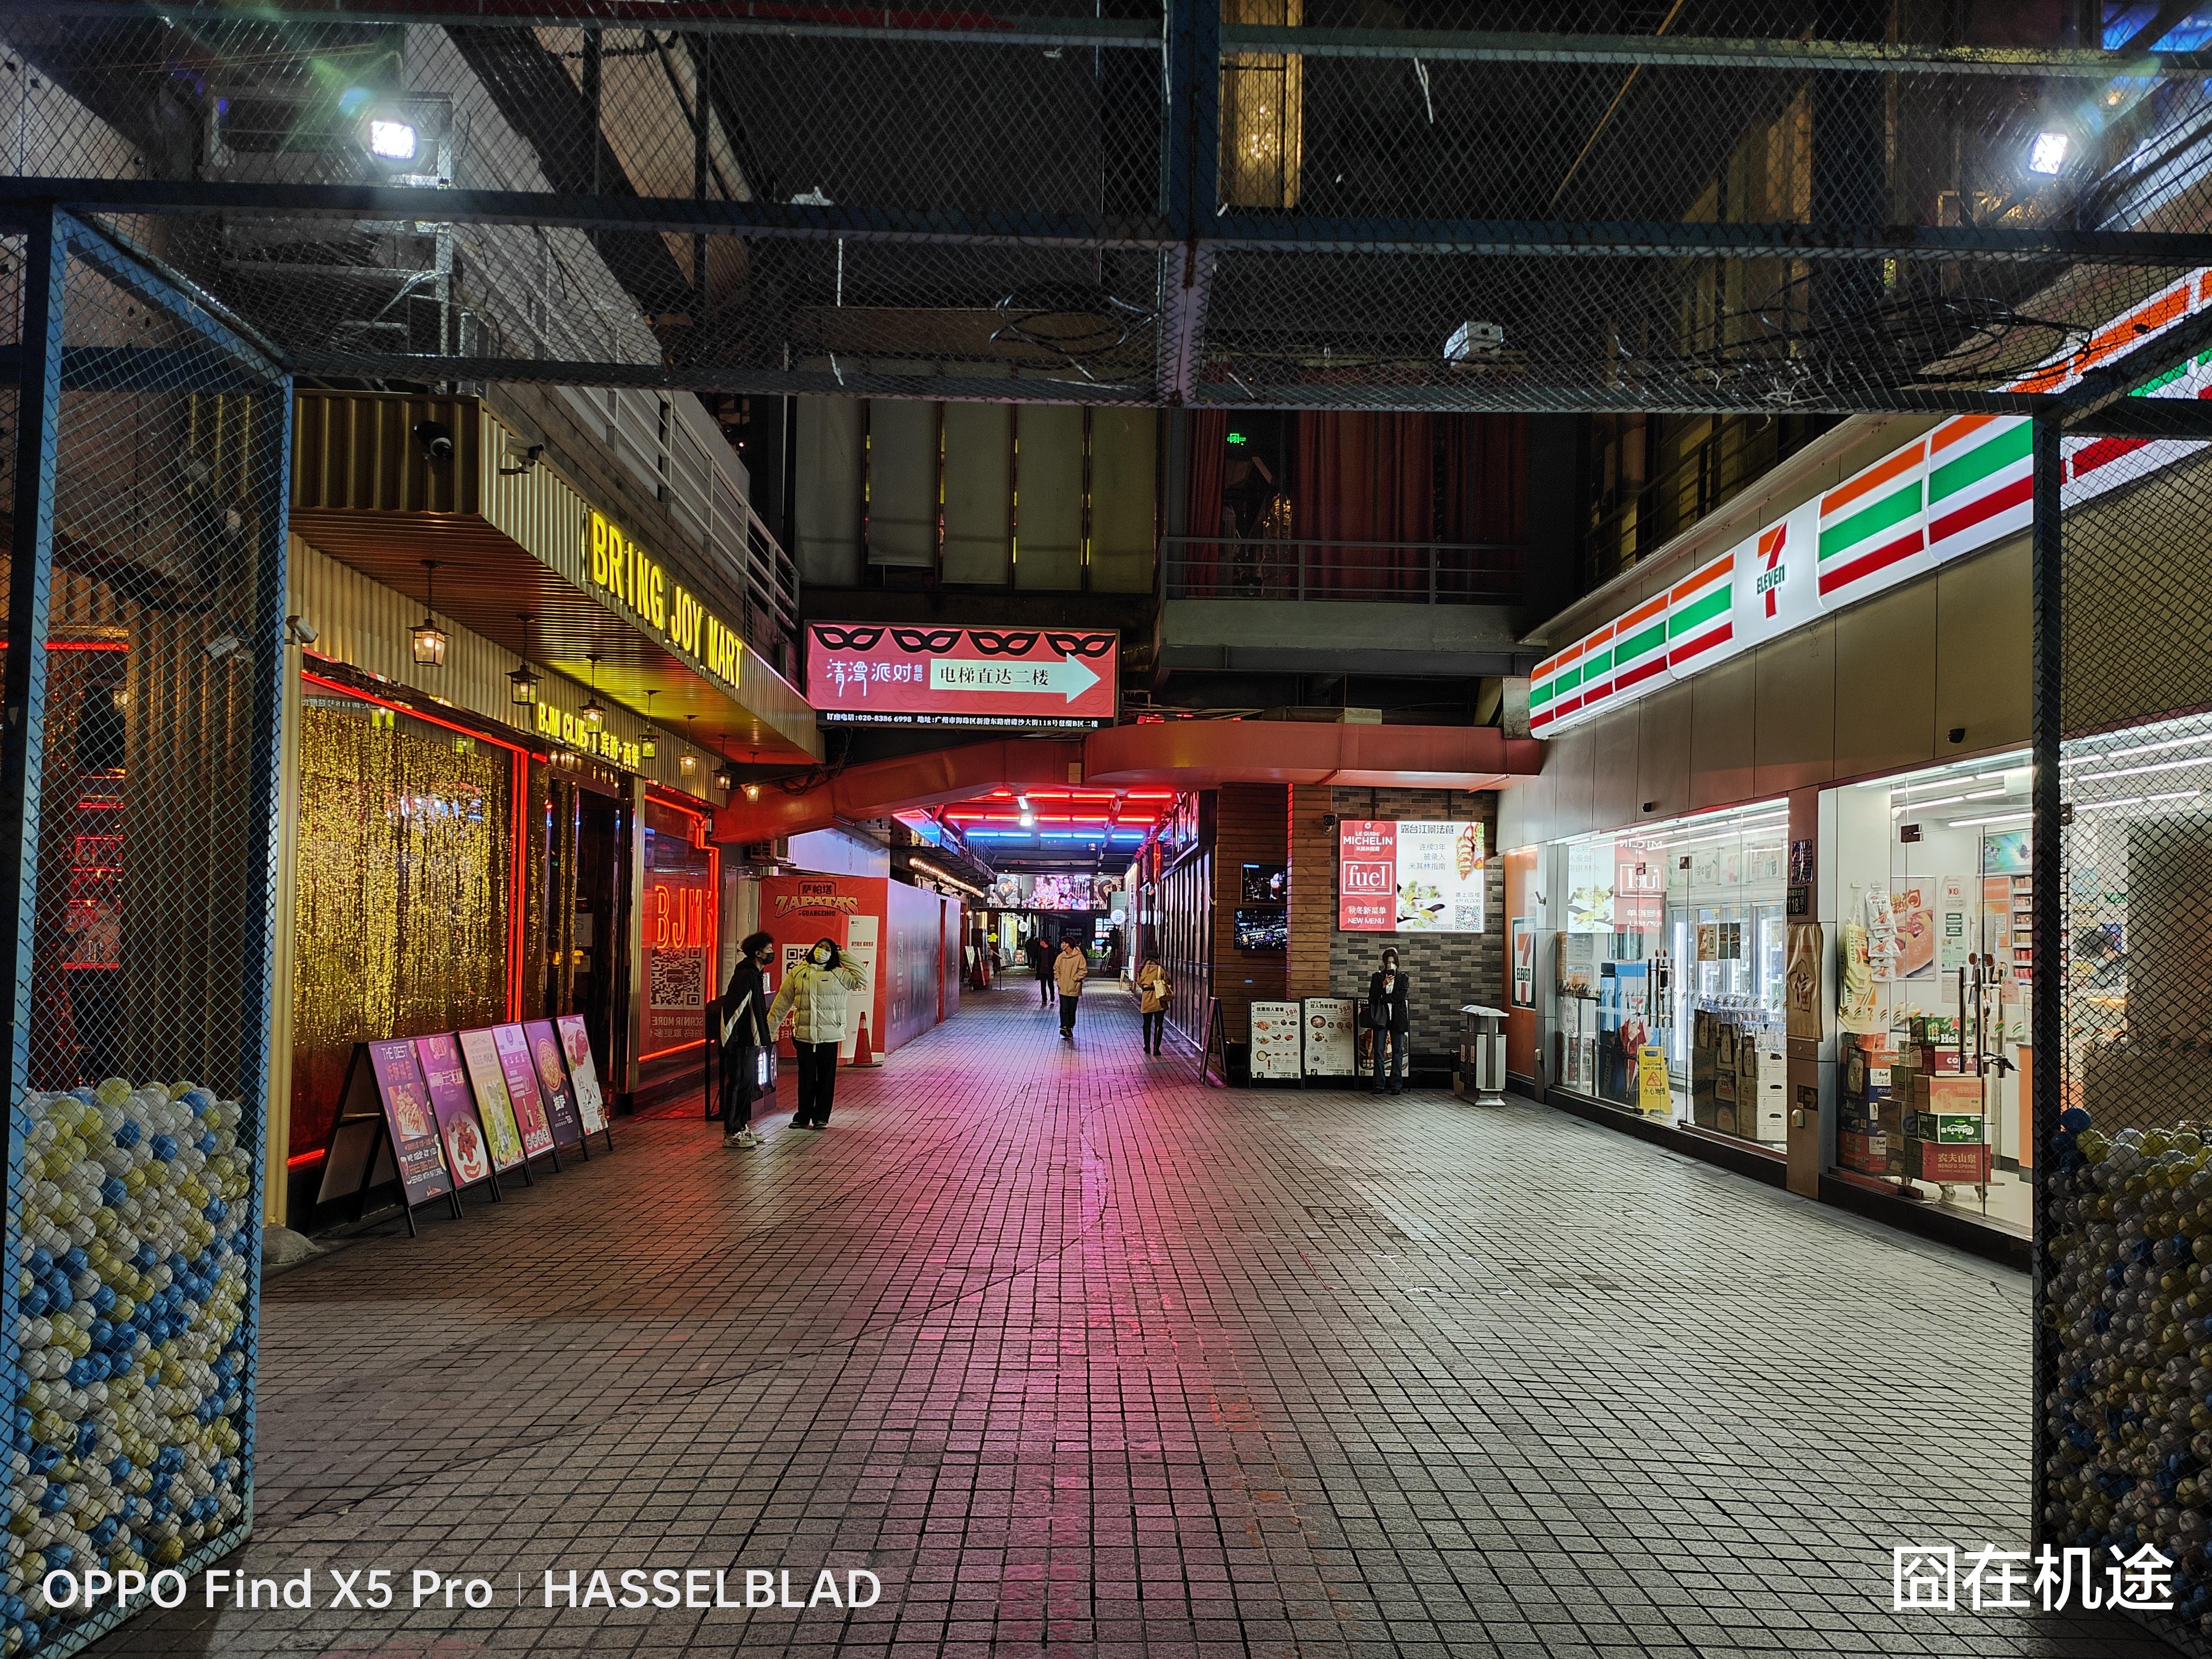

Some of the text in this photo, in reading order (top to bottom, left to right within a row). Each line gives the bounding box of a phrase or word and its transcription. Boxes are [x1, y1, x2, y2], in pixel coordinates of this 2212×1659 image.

[591, 511, 743, 690] BRING JOY MART
[940, 665, 1050, 687] 电梯直达二楼
[538, 702, 561, 737] BJM
[1343, 836, 1393, 846] MICHELIN
[1419, 842, 1446, 851] 连续3年
[1408, 862, 1446, 871] 米其林指南
[1347, 865, 1387, 886] fuel
[802, 884, 833, 895] 萨帕塔
[774, 895, 860, 918] ZAPATA'S
[1348, 907, 1387, 915] 秋冬新菜单
[655, 885, 702, 949] BJM
[1285, 1008, 1298, 1016] 188
[1339, 1005, 1351, 1014] 388
[1643, 1087, 1665, 1095] 小心地滑
[1938, 1153, 1977, 1163] 农夫山泉
